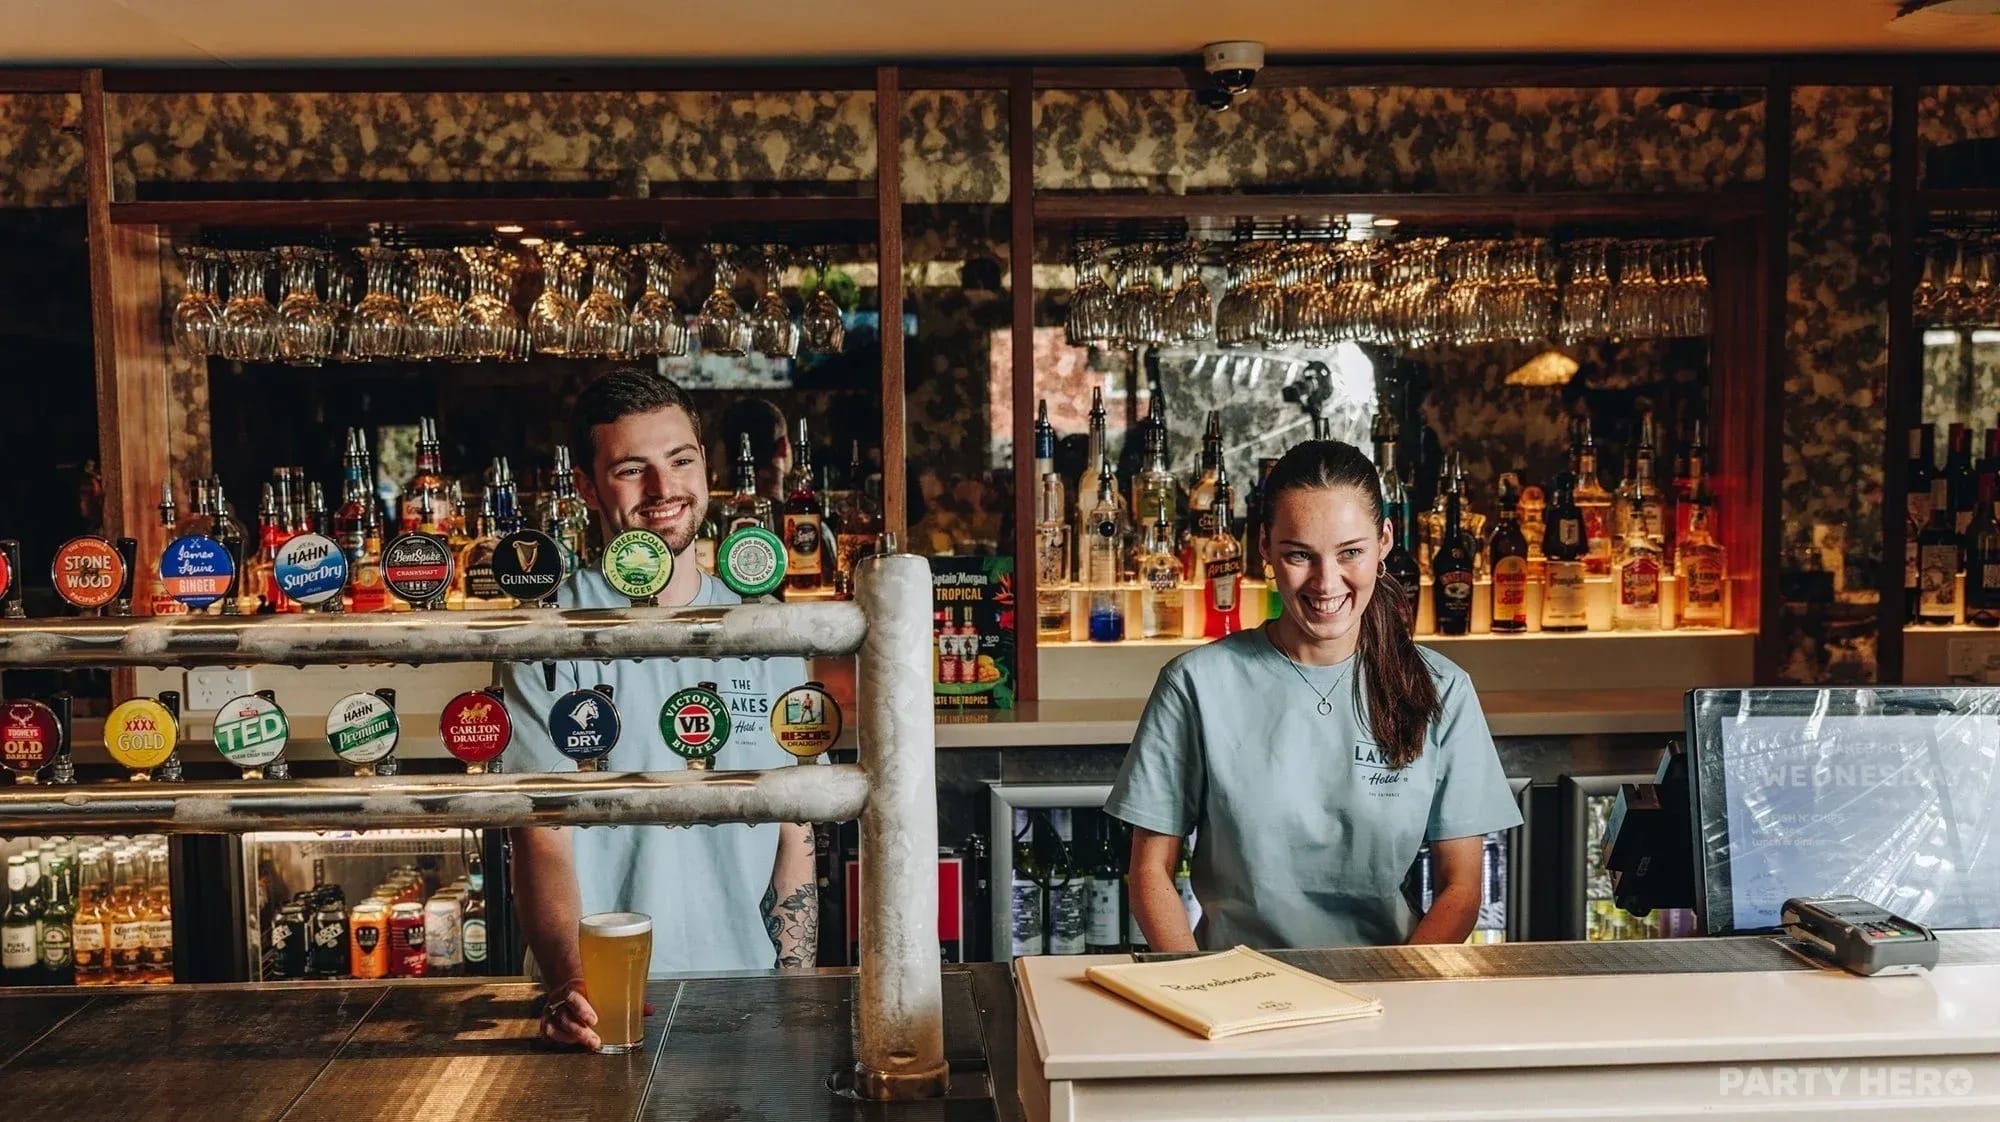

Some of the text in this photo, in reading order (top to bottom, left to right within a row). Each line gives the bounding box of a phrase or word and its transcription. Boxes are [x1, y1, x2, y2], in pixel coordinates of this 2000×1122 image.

[611, 533, 667, 555] GREEN COAST
[178, 545, 214, 561] James
[287, 544, 328, 566] HAHN
[64, 555, 112, 571] STONE
[66, 574, 112, 588] WOOD
[179, 579, 216, 593] GINGER
[284, 565, 343, 591] SuperDry
[501, 573, 556, 585] GUINNESS
[622, 584, 653, 595] LAGER
[936, 588, 983, 601] TROPICAL
[731, 679, 751, 690] THE
[344, 703, 373, 723] HAHN
[665, 694, 721, 717] VICTORIA
[731, 697, 768, 713] AKES
[125, 720, 157, 731] XXXX
[218, 712, 284, 751] TED
[450, 724, 500, 735] CARLTON
[678, 716, 711, 733] VB
[118, 733, 165, 751] GOLD
[339, 719, 390, 749] Premium
[453, 733, 499, 743] DRAUGHT
[567, 735, 602, 747] DRY
[4, 741, 43, 754] OLD
[672, 736, 720, 754] BITTER
[1355, 746, 1390, 764] LAK
[1369, 772, 1400, 785] Hotel
